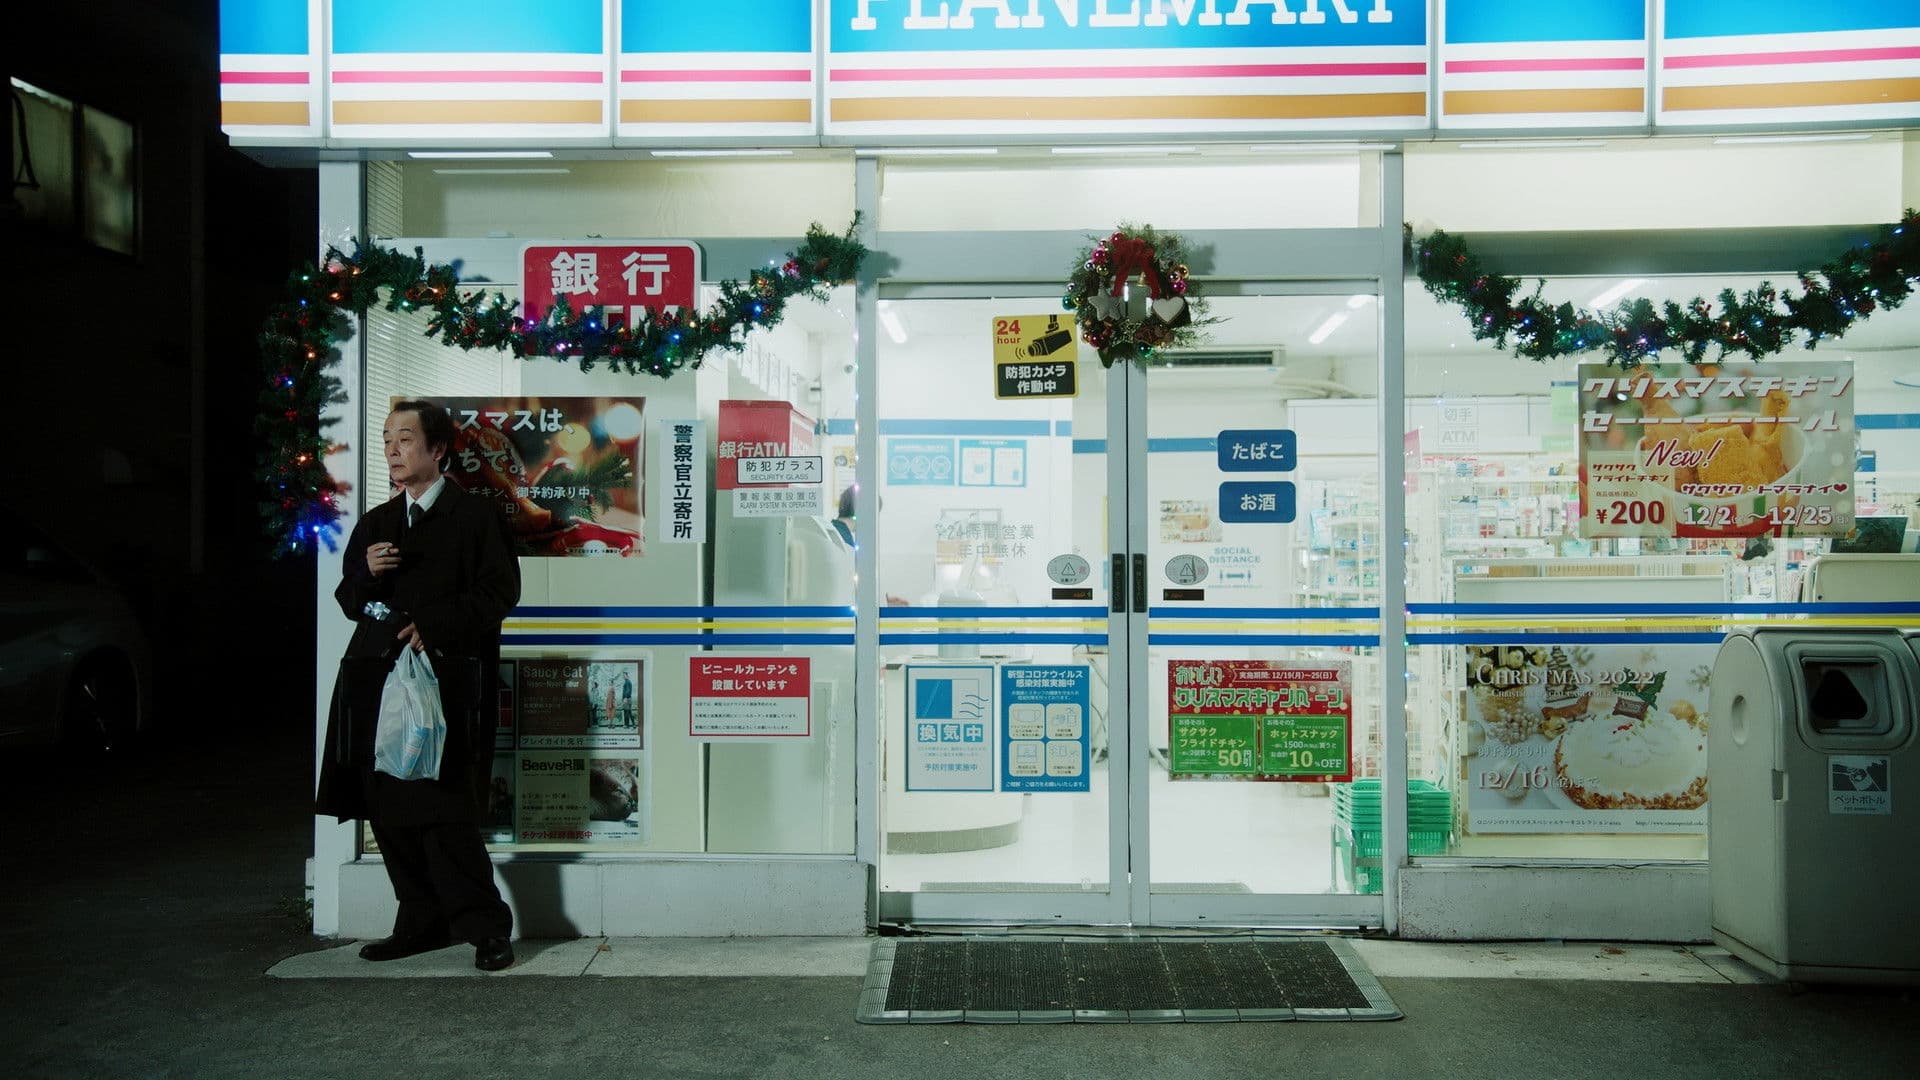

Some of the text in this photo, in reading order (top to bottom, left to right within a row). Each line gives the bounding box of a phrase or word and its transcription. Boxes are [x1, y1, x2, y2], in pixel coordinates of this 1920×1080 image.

[550, 251, 670, 296] 銀行
[997, 319, 1021, 335] 24
[1005, 364, 1067, 379] 防犯カメラ
[1017, 380, 1057, 394] 作動中
[1582, 376, 1853, 398] クリスマスチキン
[445, 408, 576, 434] スマスは、
[1442, 431, 1476, 443] ATM
[719, 441, 787, 458] 銀行ATM
[1231, 443, 1284, 460] たばこ
[443, 449, 521, 475] ちで。
[745, 460, 815, 472] 防犯ガラス
[673, 425, 693, 539] 警察官立寄所
[1240, 493, 1276, 511] お酒
[959, 543, 1027, 558] 年中無休
[702, 664, 798, 675] ビニールカーテンを
[1007, 670, 1083, 679] 新型コロナウイルス
[1175, 665, 1223, 686] おいしい
[712, 679, 788, 690] 設置しています
[1016, 678, 1076, 688] 感染対策実施中
[1599, 670, 1656, 685] 2022
[1175, 687, 1343, 708] クリスマスキャンペーン
[919, 724, 983, 742] 換気中
[1179, 727, 1217, 736] サクサク
[1270, 729, 1338, 738] ホットスナック
[1180, 738, 1247, 748] フライドチキン
[1834, 795, 1886, 804] ペットボトル
